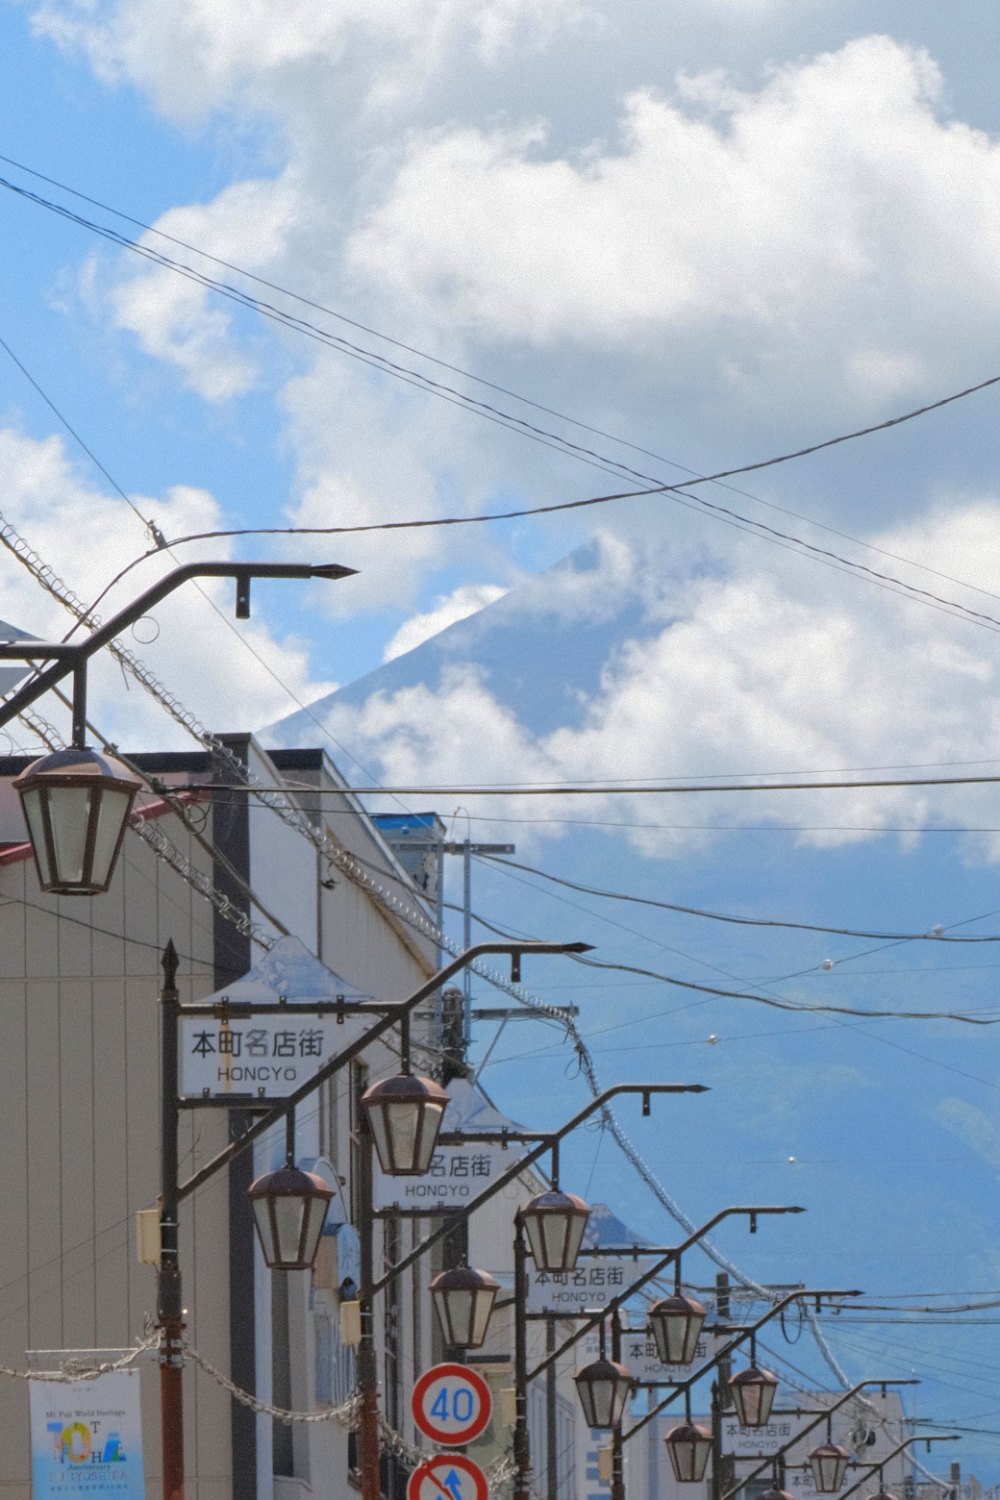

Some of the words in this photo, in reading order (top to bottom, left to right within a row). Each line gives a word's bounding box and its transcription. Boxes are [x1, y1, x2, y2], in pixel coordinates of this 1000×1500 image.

[192, 1029, 324, 1059] 本町名店街
[534, 1266, 624, 1287] 本町名店街
[430, 1387, 473, 1421] 40
